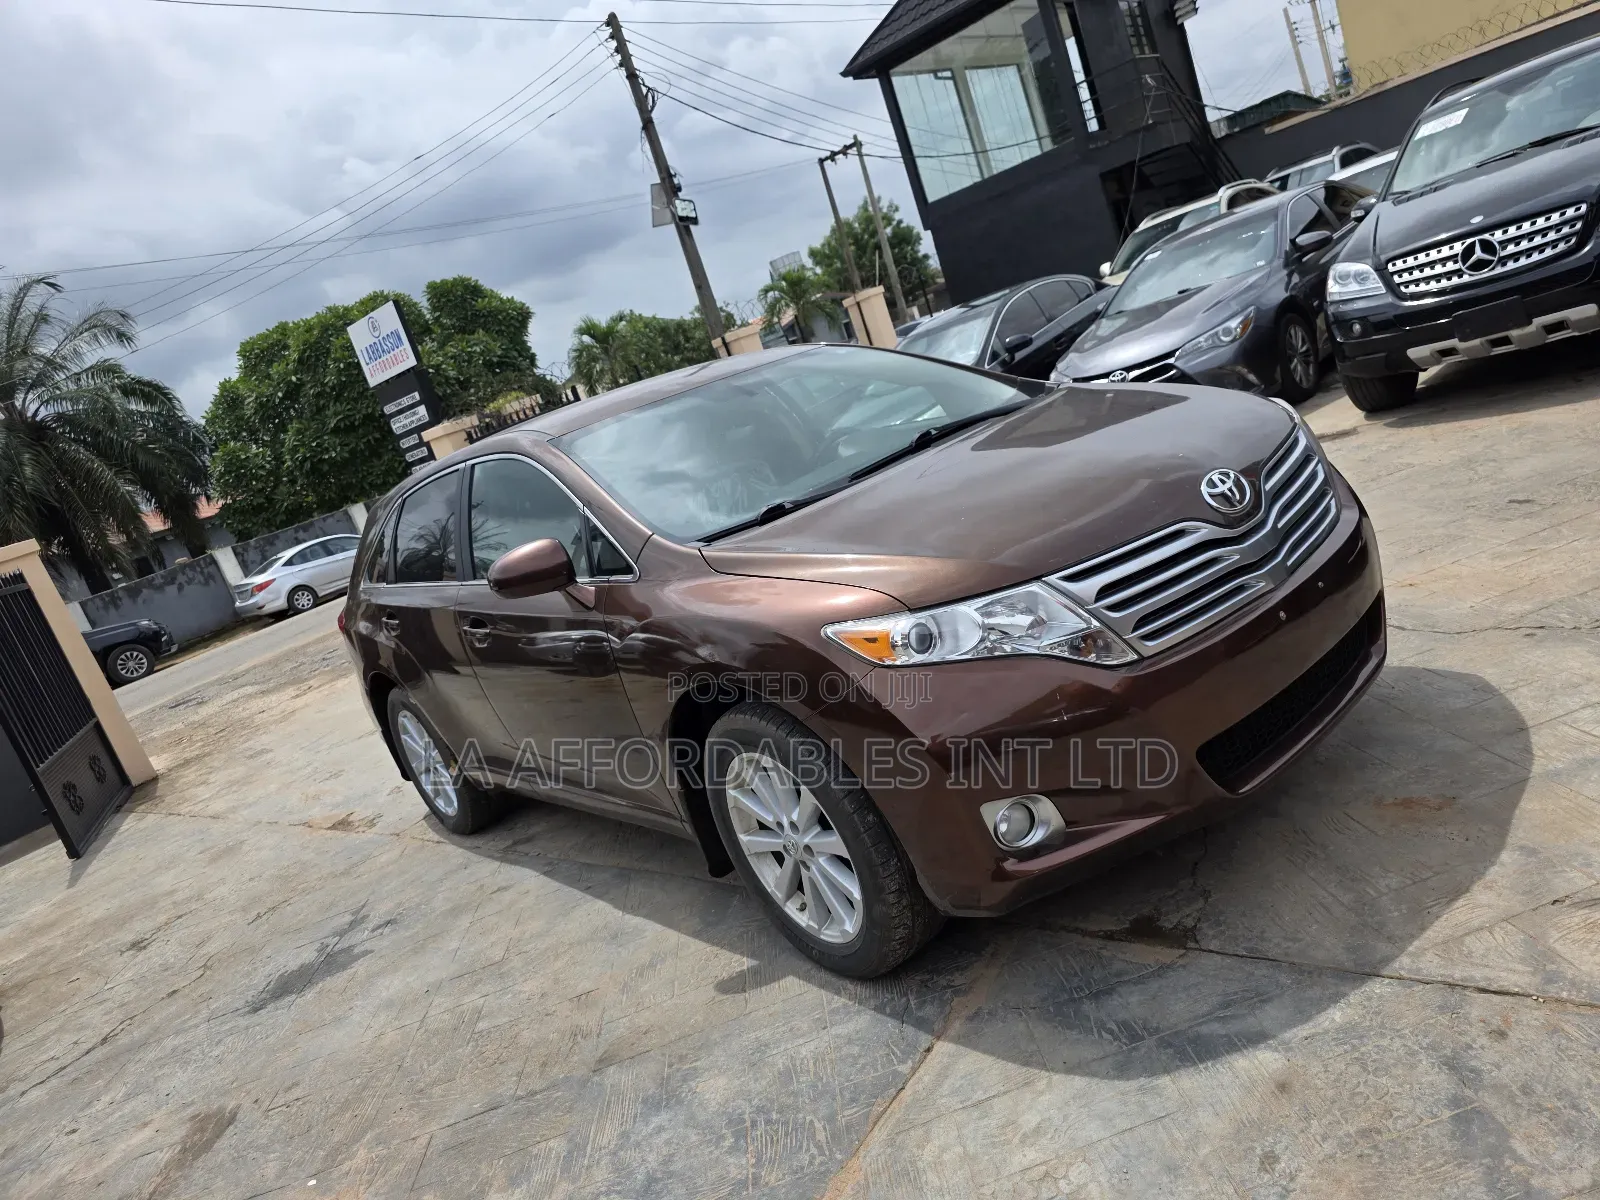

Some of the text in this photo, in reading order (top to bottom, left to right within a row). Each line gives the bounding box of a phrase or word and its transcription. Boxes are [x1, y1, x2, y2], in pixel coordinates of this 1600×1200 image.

[360, 328, 405, 366] LABBASSON
[368, 348, 410, 378] AFFORDABLES
[405, 394, 418, 404] STORE
